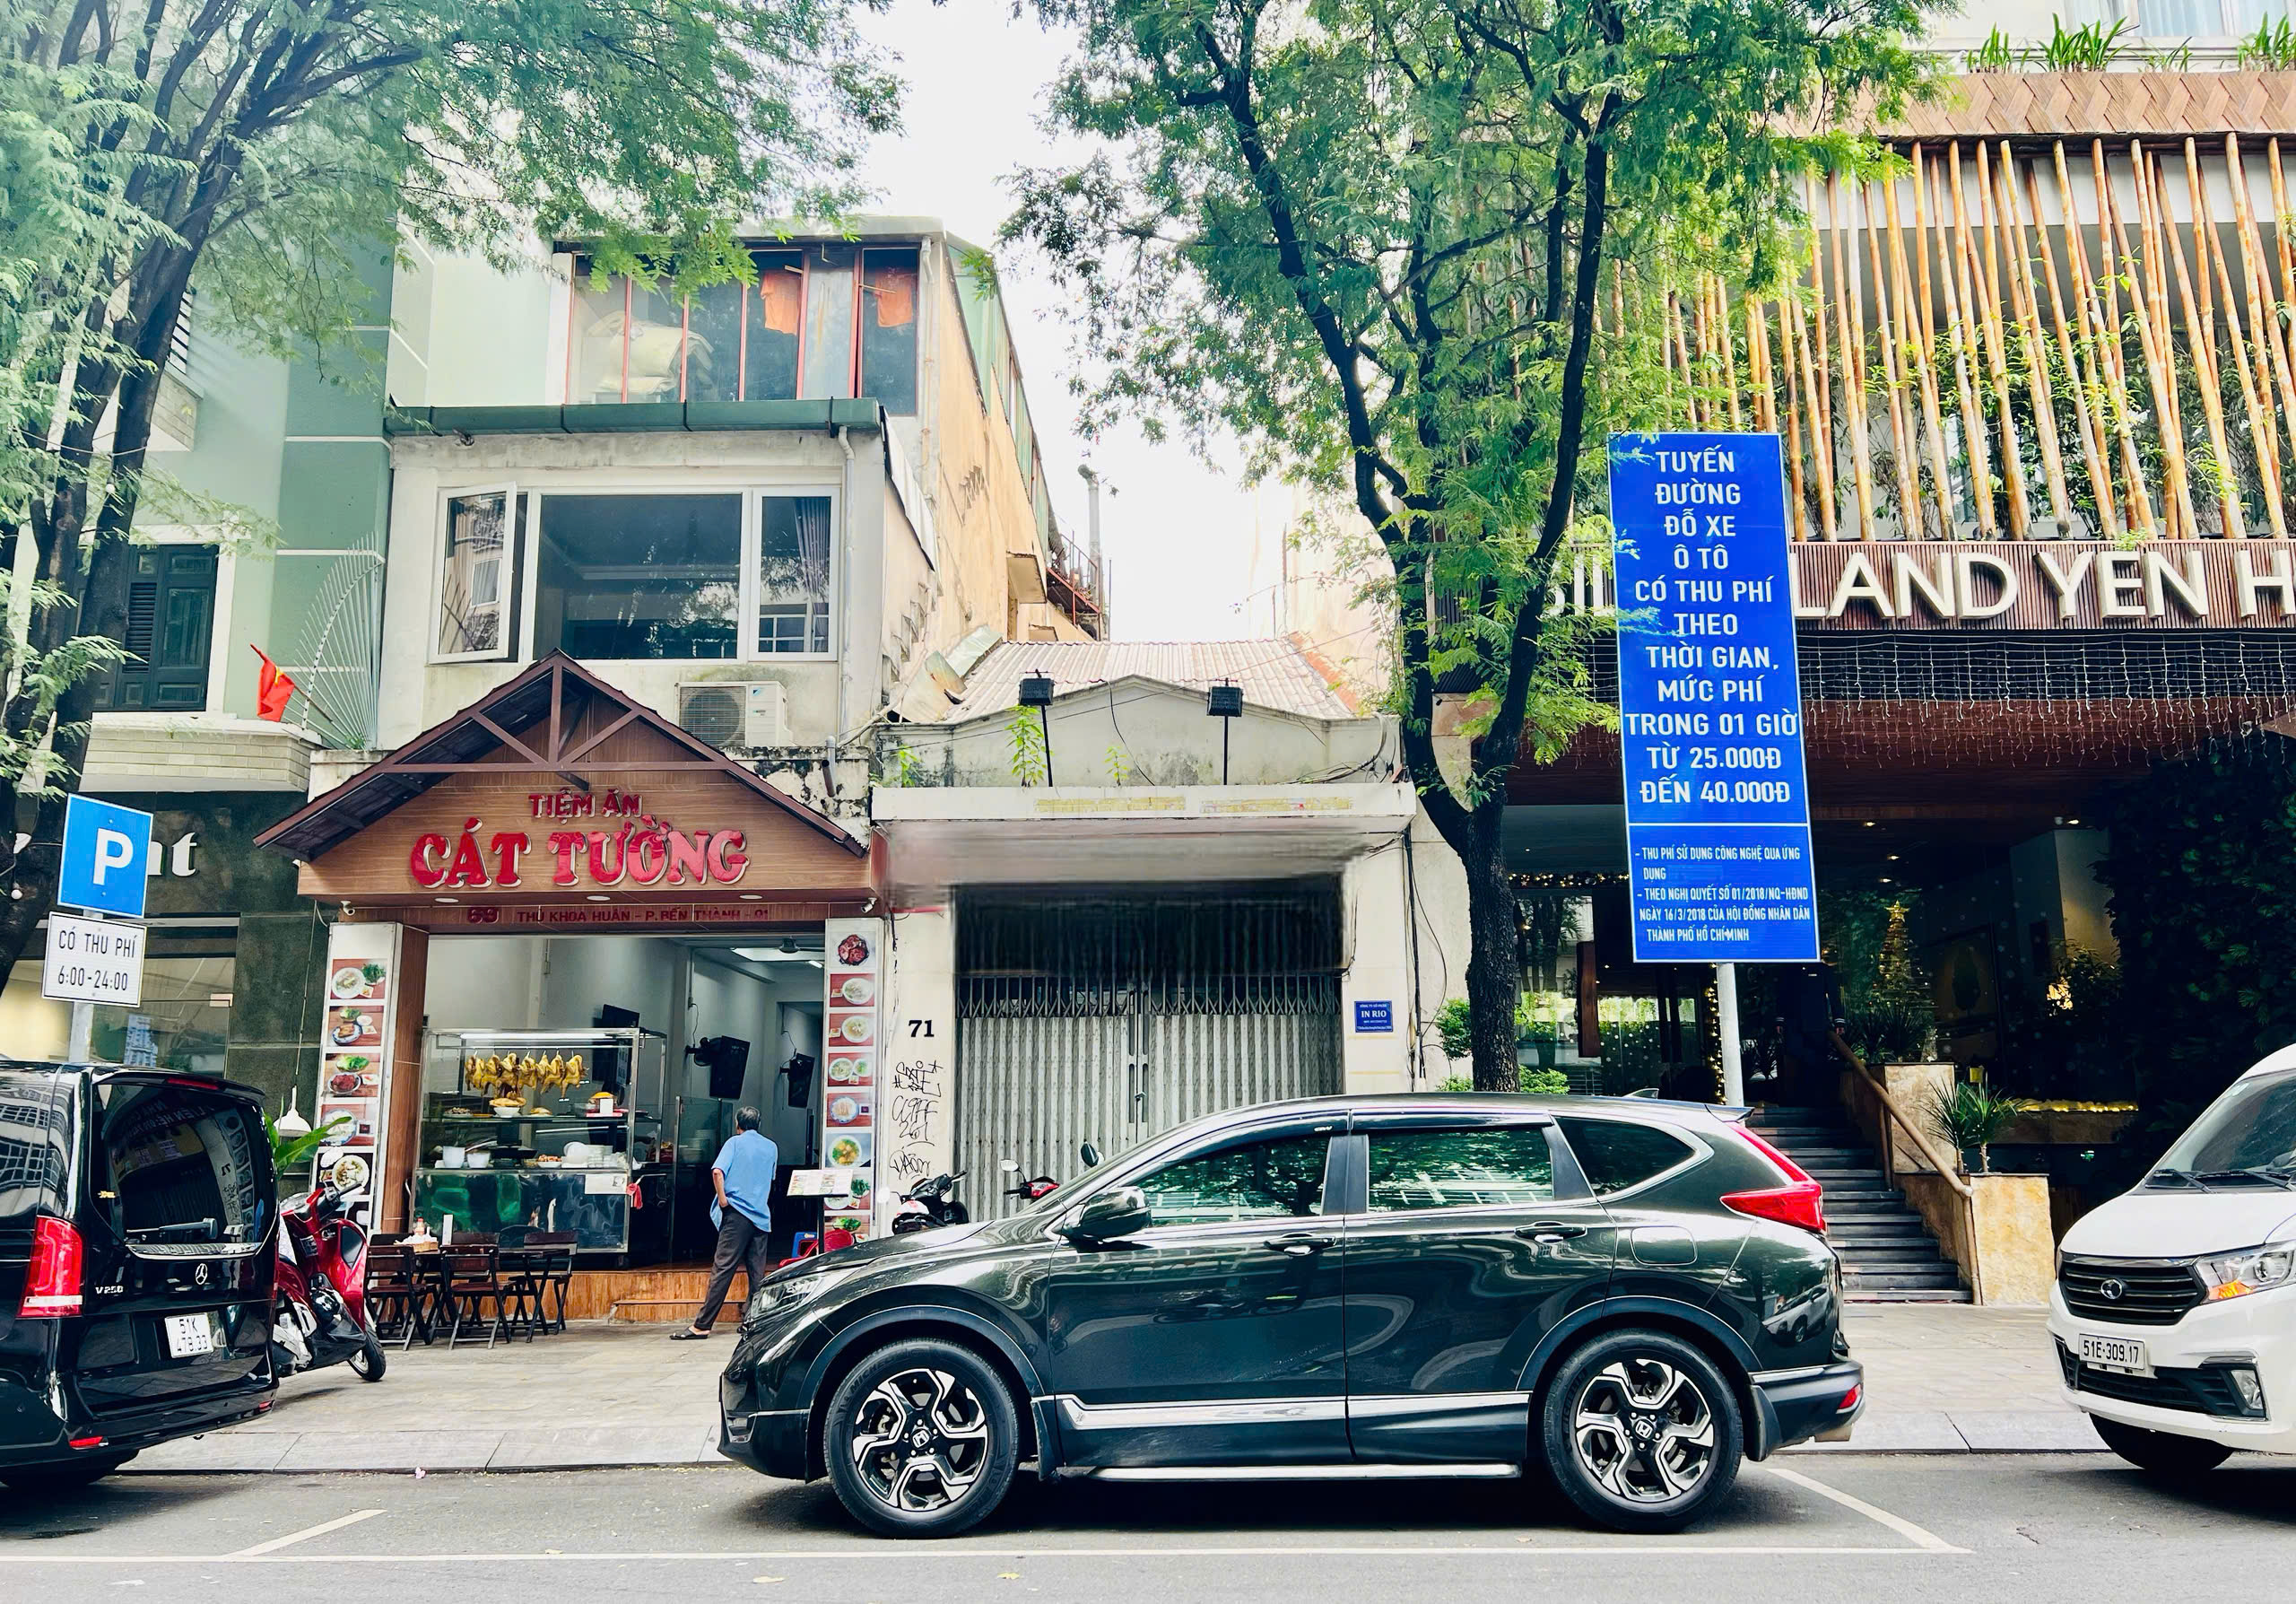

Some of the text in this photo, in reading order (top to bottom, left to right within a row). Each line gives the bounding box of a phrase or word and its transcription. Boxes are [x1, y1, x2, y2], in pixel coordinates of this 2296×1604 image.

[1656, 444, 1735, 473] TUYẾN
[1655, 478, 1741, 505] ĐƯỜNG
[1664, 508, 1735, 536] ĐỖ XE
[1674, 544, 1728, 570] Ô TÔ
[1635, 574, 1774, 603] CÓ THU PHÍ
[2034, 551, 2208, 619] YEN
[2235, 550, 2296, 618] H
[1674, 613, 1738, 635] THEO
[1646, 641, 1779, 670] THỜI GIAN,
[1657, 674, 1765, 702] MỨC PHÍ
[1625, 708, 1797, 736] TRONG 01 GIỜ
[1646, 741, 1781, 769] TỪ 25.000Đ
[1639, 773, 1790, 803] ĐẾN 40.000Đ
[528, 787, 642, 824] TIỆM ĂN
[93, 827, 134, 886] P
[411, 815, 750, 889] CÁT TƯỜNG
[1642, 847, 1658, 859] THU
[1661, 843, 1674, 859] PHÍ
[1676, 843, 1688, 859] SỬ
[1691, 847, 1713, 861] DỤNG
[1715, 844, 1738, 860] CÔNG
[1740, 844, 1762, 863] NGHỆ
[1764, 847, 1781, 860] QUA
[1782, 843, 1800, 860] ỨNG
[1643, 867, 1666, 883] DỤNG
[1644, 888, 1665, 901] THEO
[1668, 887, 1689, 902] NGHỊ
[1691, 884, 1717, 901] QUYẾT
[1718, 884, 1731, 900] SỐ
[549, 911, 587, 922] KHOA
[592, 908, 630, 921] HUÂN
[1639, 903, 1810, 922] NGÀY 16/3/2018 CỦA HỘI ĐỒNG NHÂN DÂN
[58, 927, 137, 958] CÓ THU PHÍ
[1647, 926, 1674, 941] THÀNH
[1677, 924, 1695, 941] PHỐ
[1696, 924, 1708, 941] HỒ
[1726, 928, 1749, 941] MINH
[908, 1019, 935, 1038] 71
[179, 1318, 197, 1334] 51K
[2083, 1340, 2139, 1364] 51E-309.17
